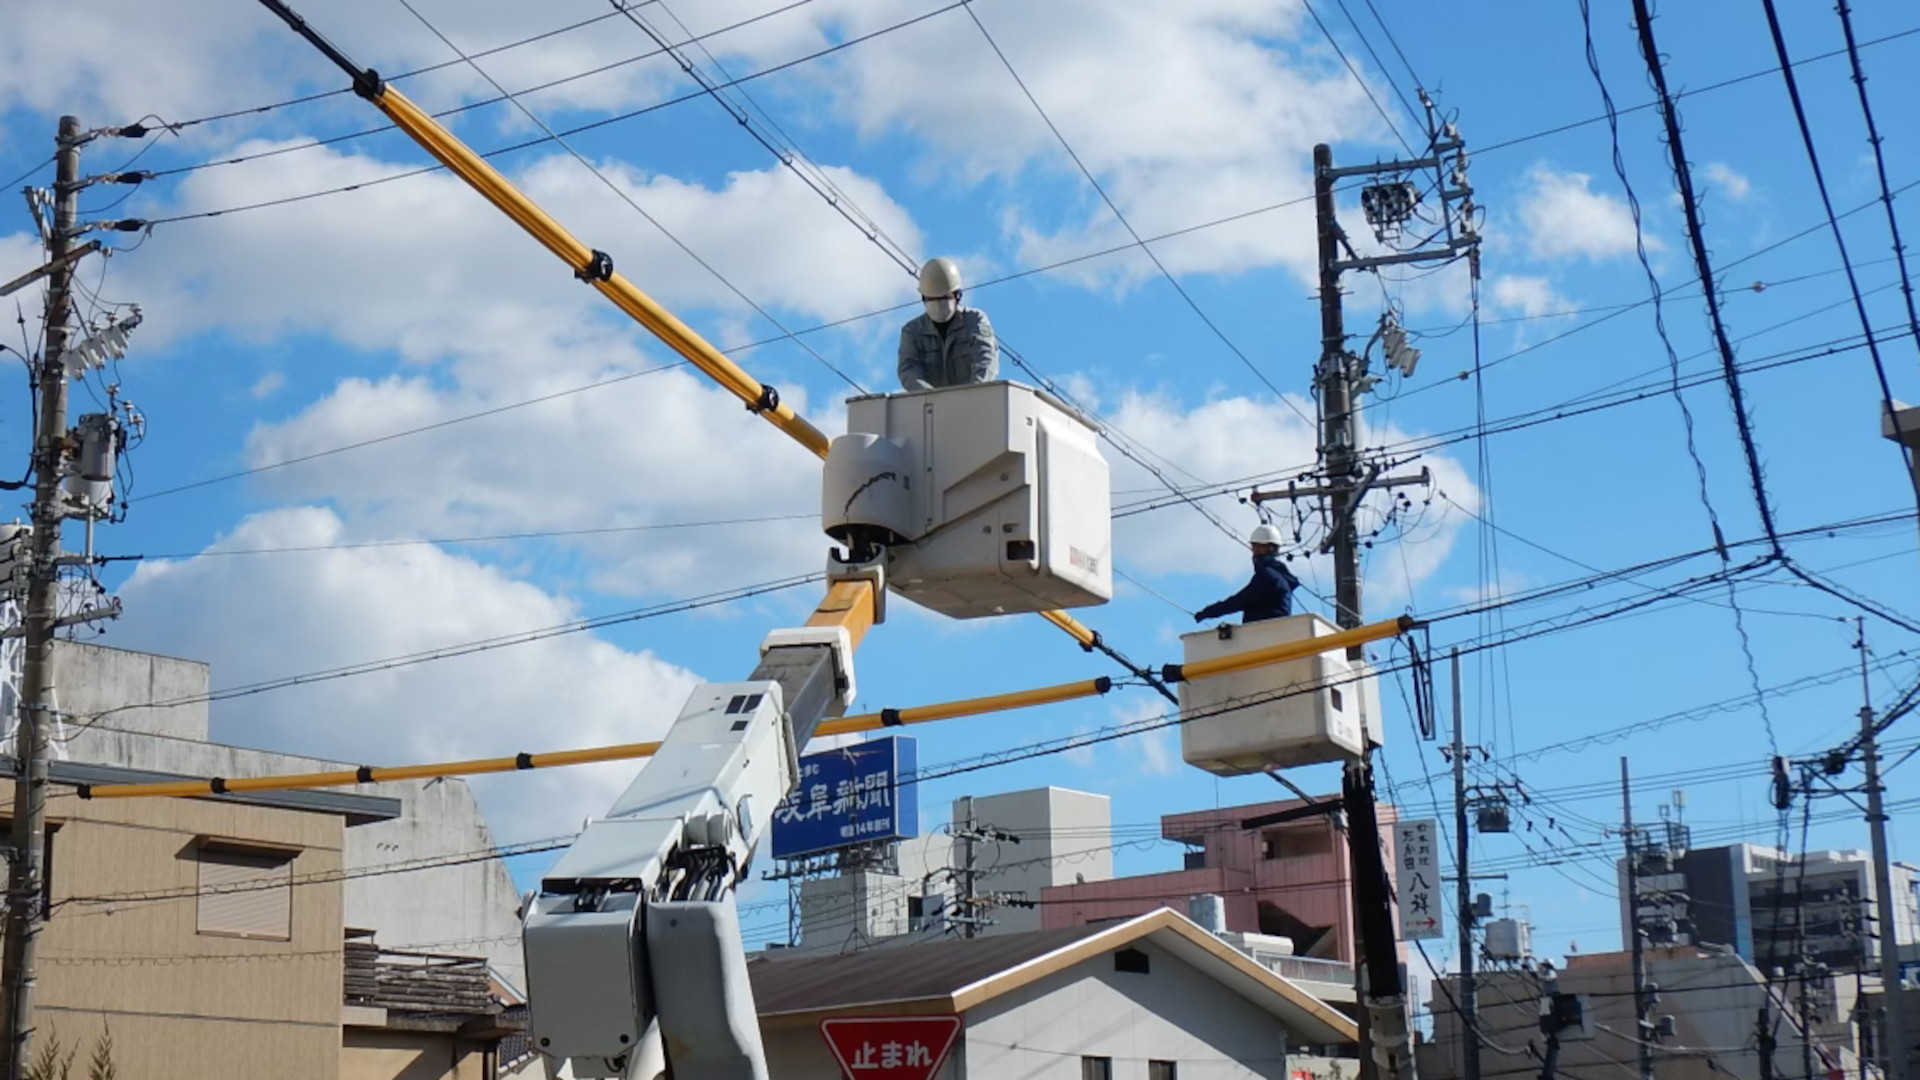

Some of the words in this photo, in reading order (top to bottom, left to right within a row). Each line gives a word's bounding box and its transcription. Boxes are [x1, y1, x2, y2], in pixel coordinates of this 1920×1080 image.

[1408, 871, 1432, 915] 八祥
[851, 1040, 933, 1069] 止まれ
